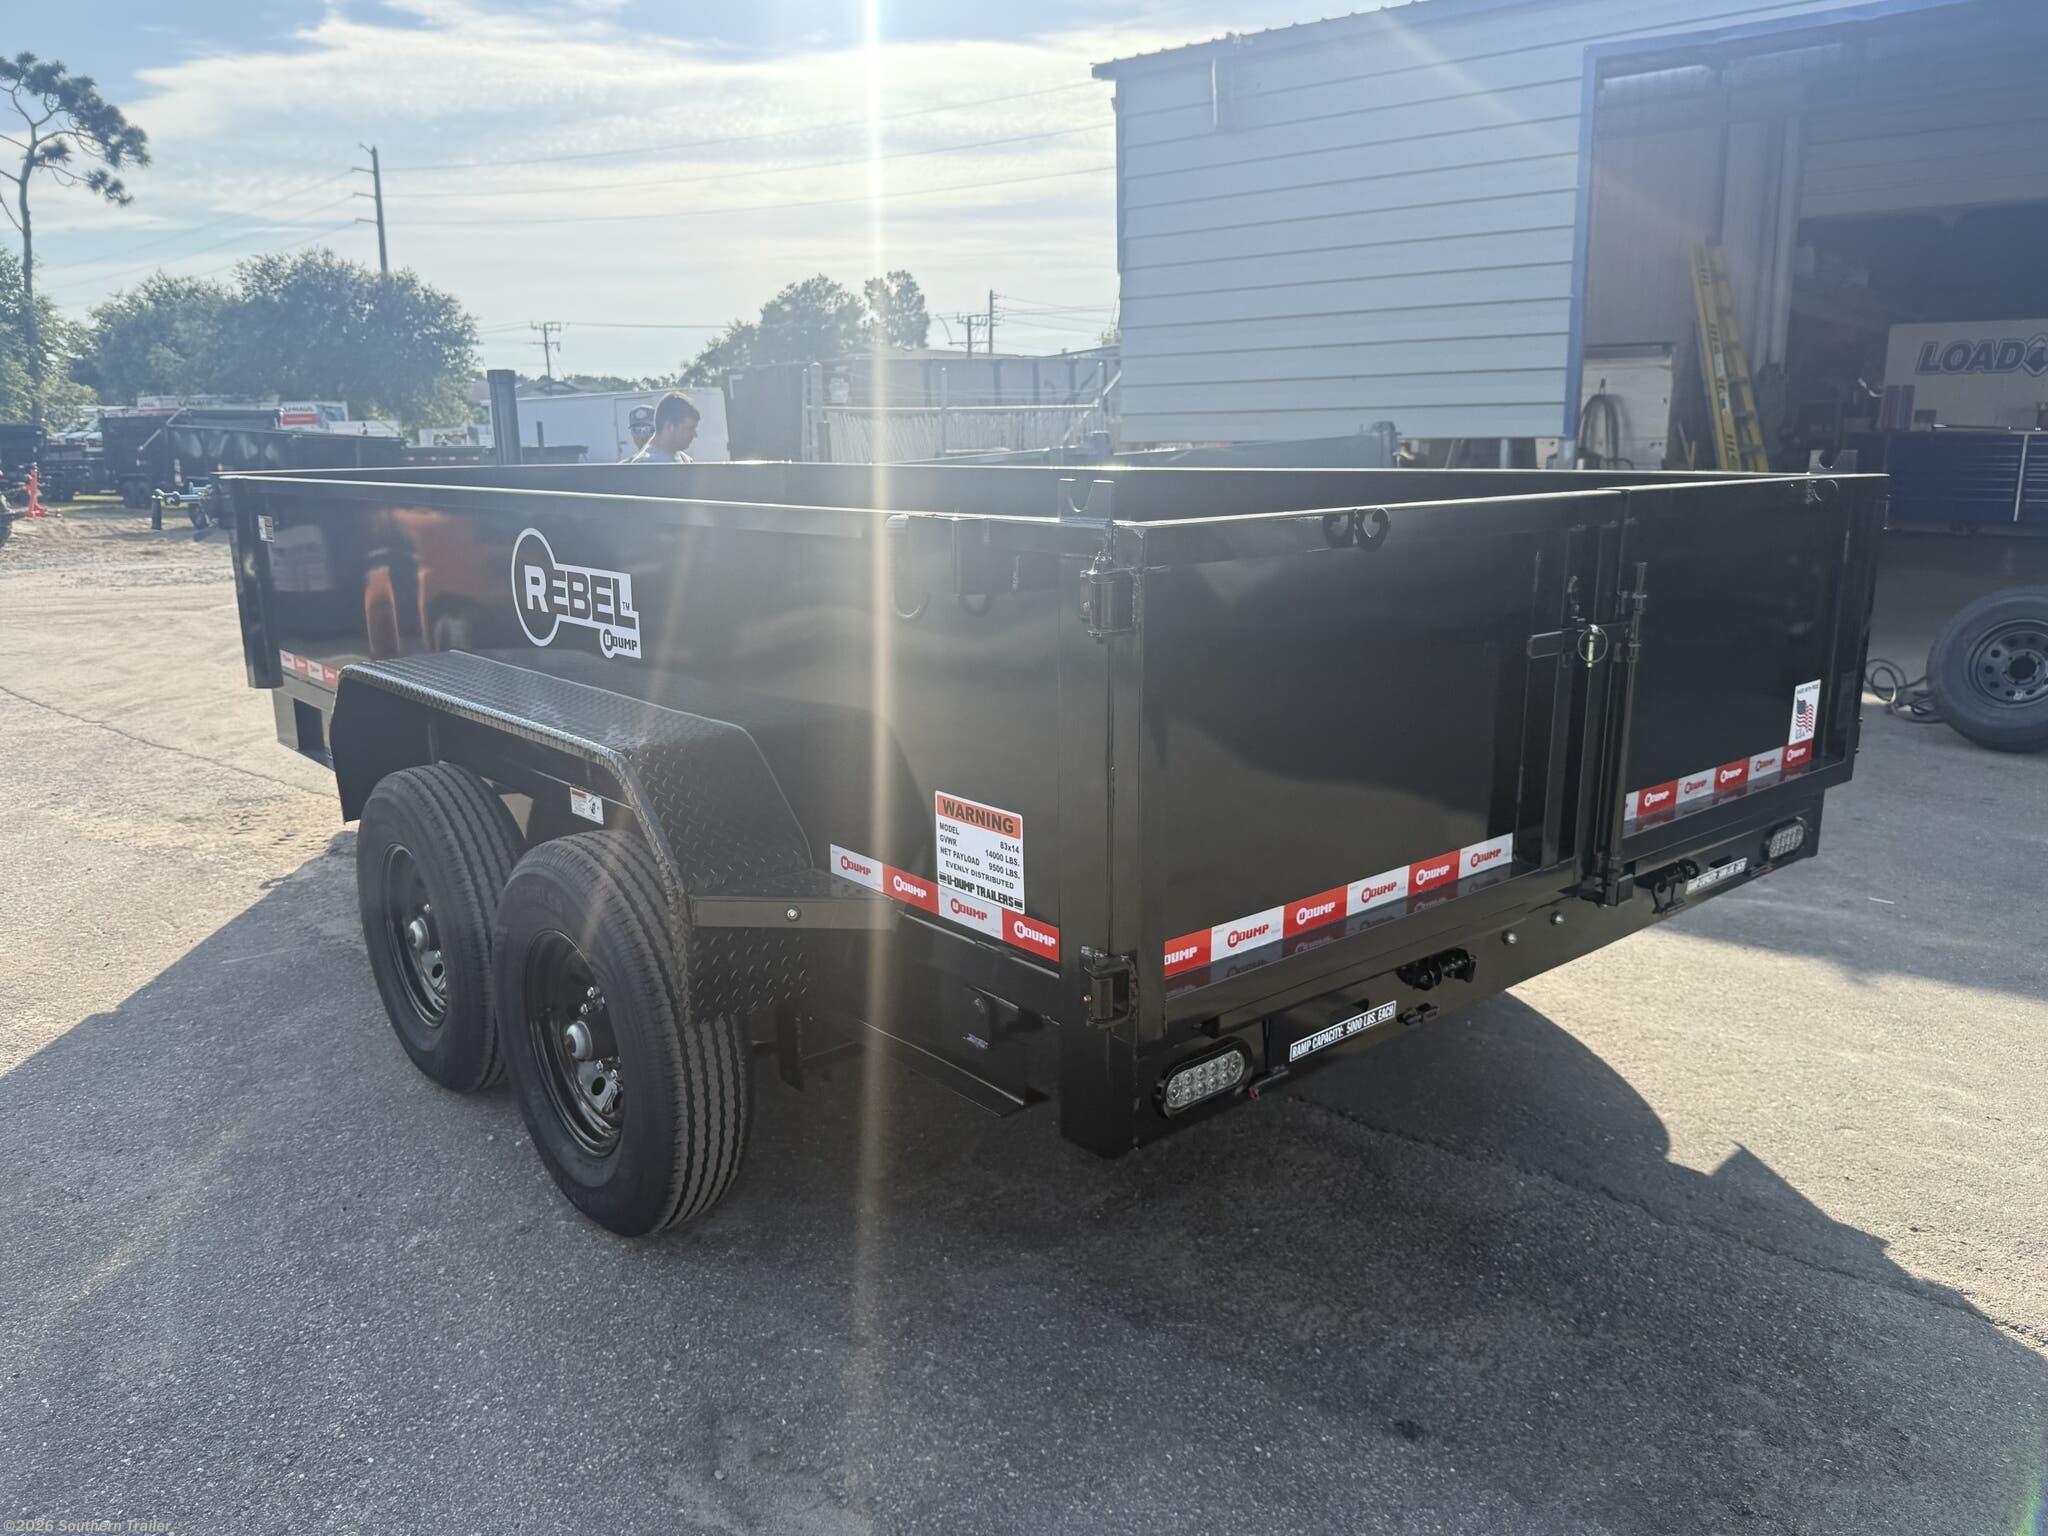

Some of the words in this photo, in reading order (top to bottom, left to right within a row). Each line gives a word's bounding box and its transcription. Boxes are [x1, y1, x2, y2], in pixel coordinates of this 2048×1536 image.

[524, 565, 637, 630] REBEL
[942, 798, 1014, 834] WARNING
[939, 822, 960, 836] MODEL
[940, 846, 952, 857] NET
[952, 850, 980, 866] PAYLOAD
[985, 849, 1004, 862] 14000
[1004, 858, 1020, 868] LBS.
[945, 860, 970, 876] EVENLY
[970, 868, 1015, 890] DISTRIBUTED
[988, 862, 1004, 875] 9500
[1005, 870, 1021, 880] LBS.
[975, 884, 1014, 908] TRAILERS
